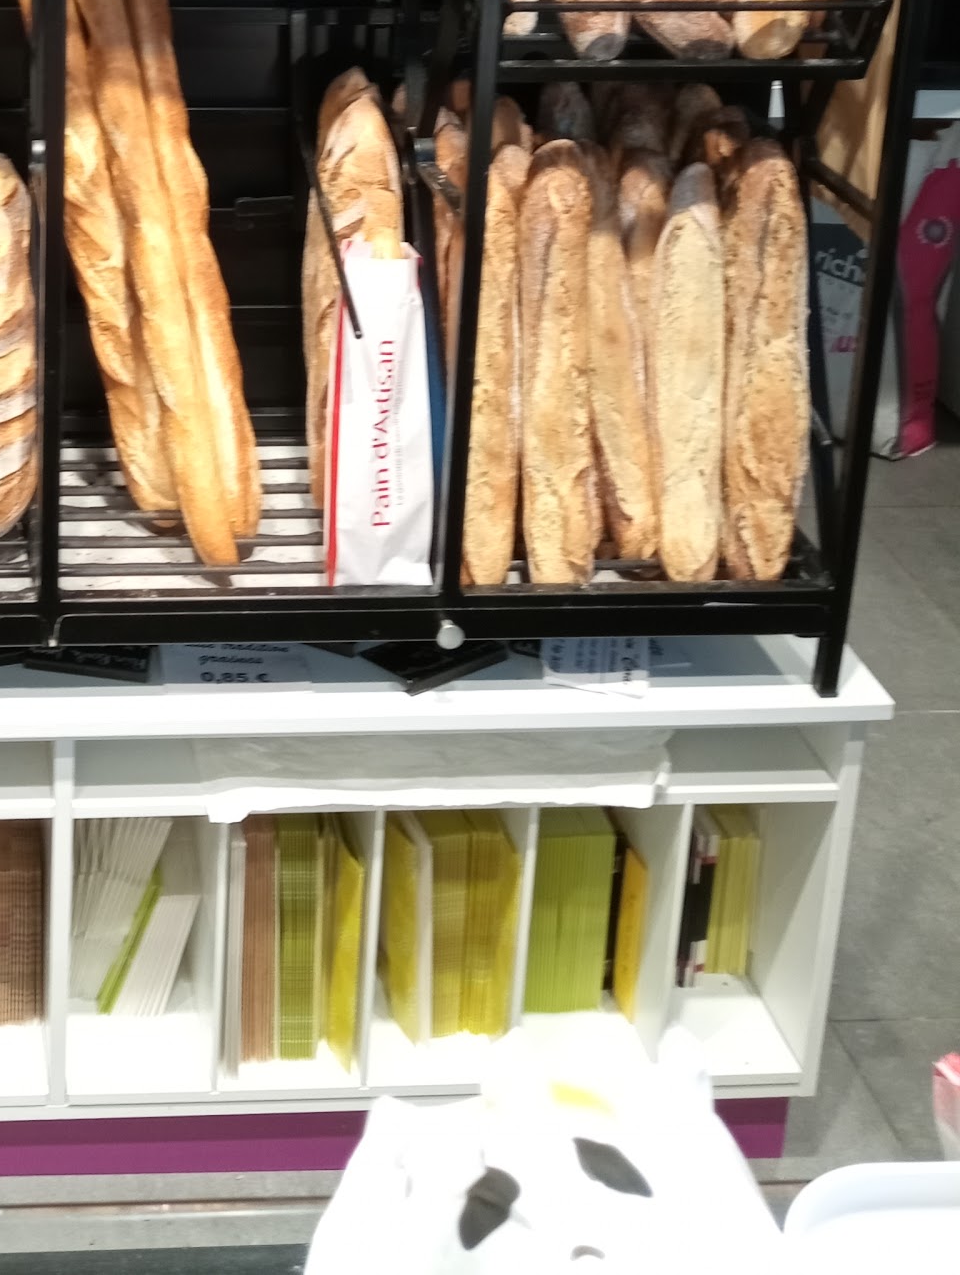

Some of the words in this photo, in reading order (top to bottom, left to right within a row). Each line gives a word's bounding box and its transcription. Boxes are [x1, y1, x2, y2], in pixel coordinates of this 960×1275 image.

[371, 340, 395, 460] d'Artisan
[370, 468, 392, 527] Pain
[200, 671, 248, 684] 0,85
